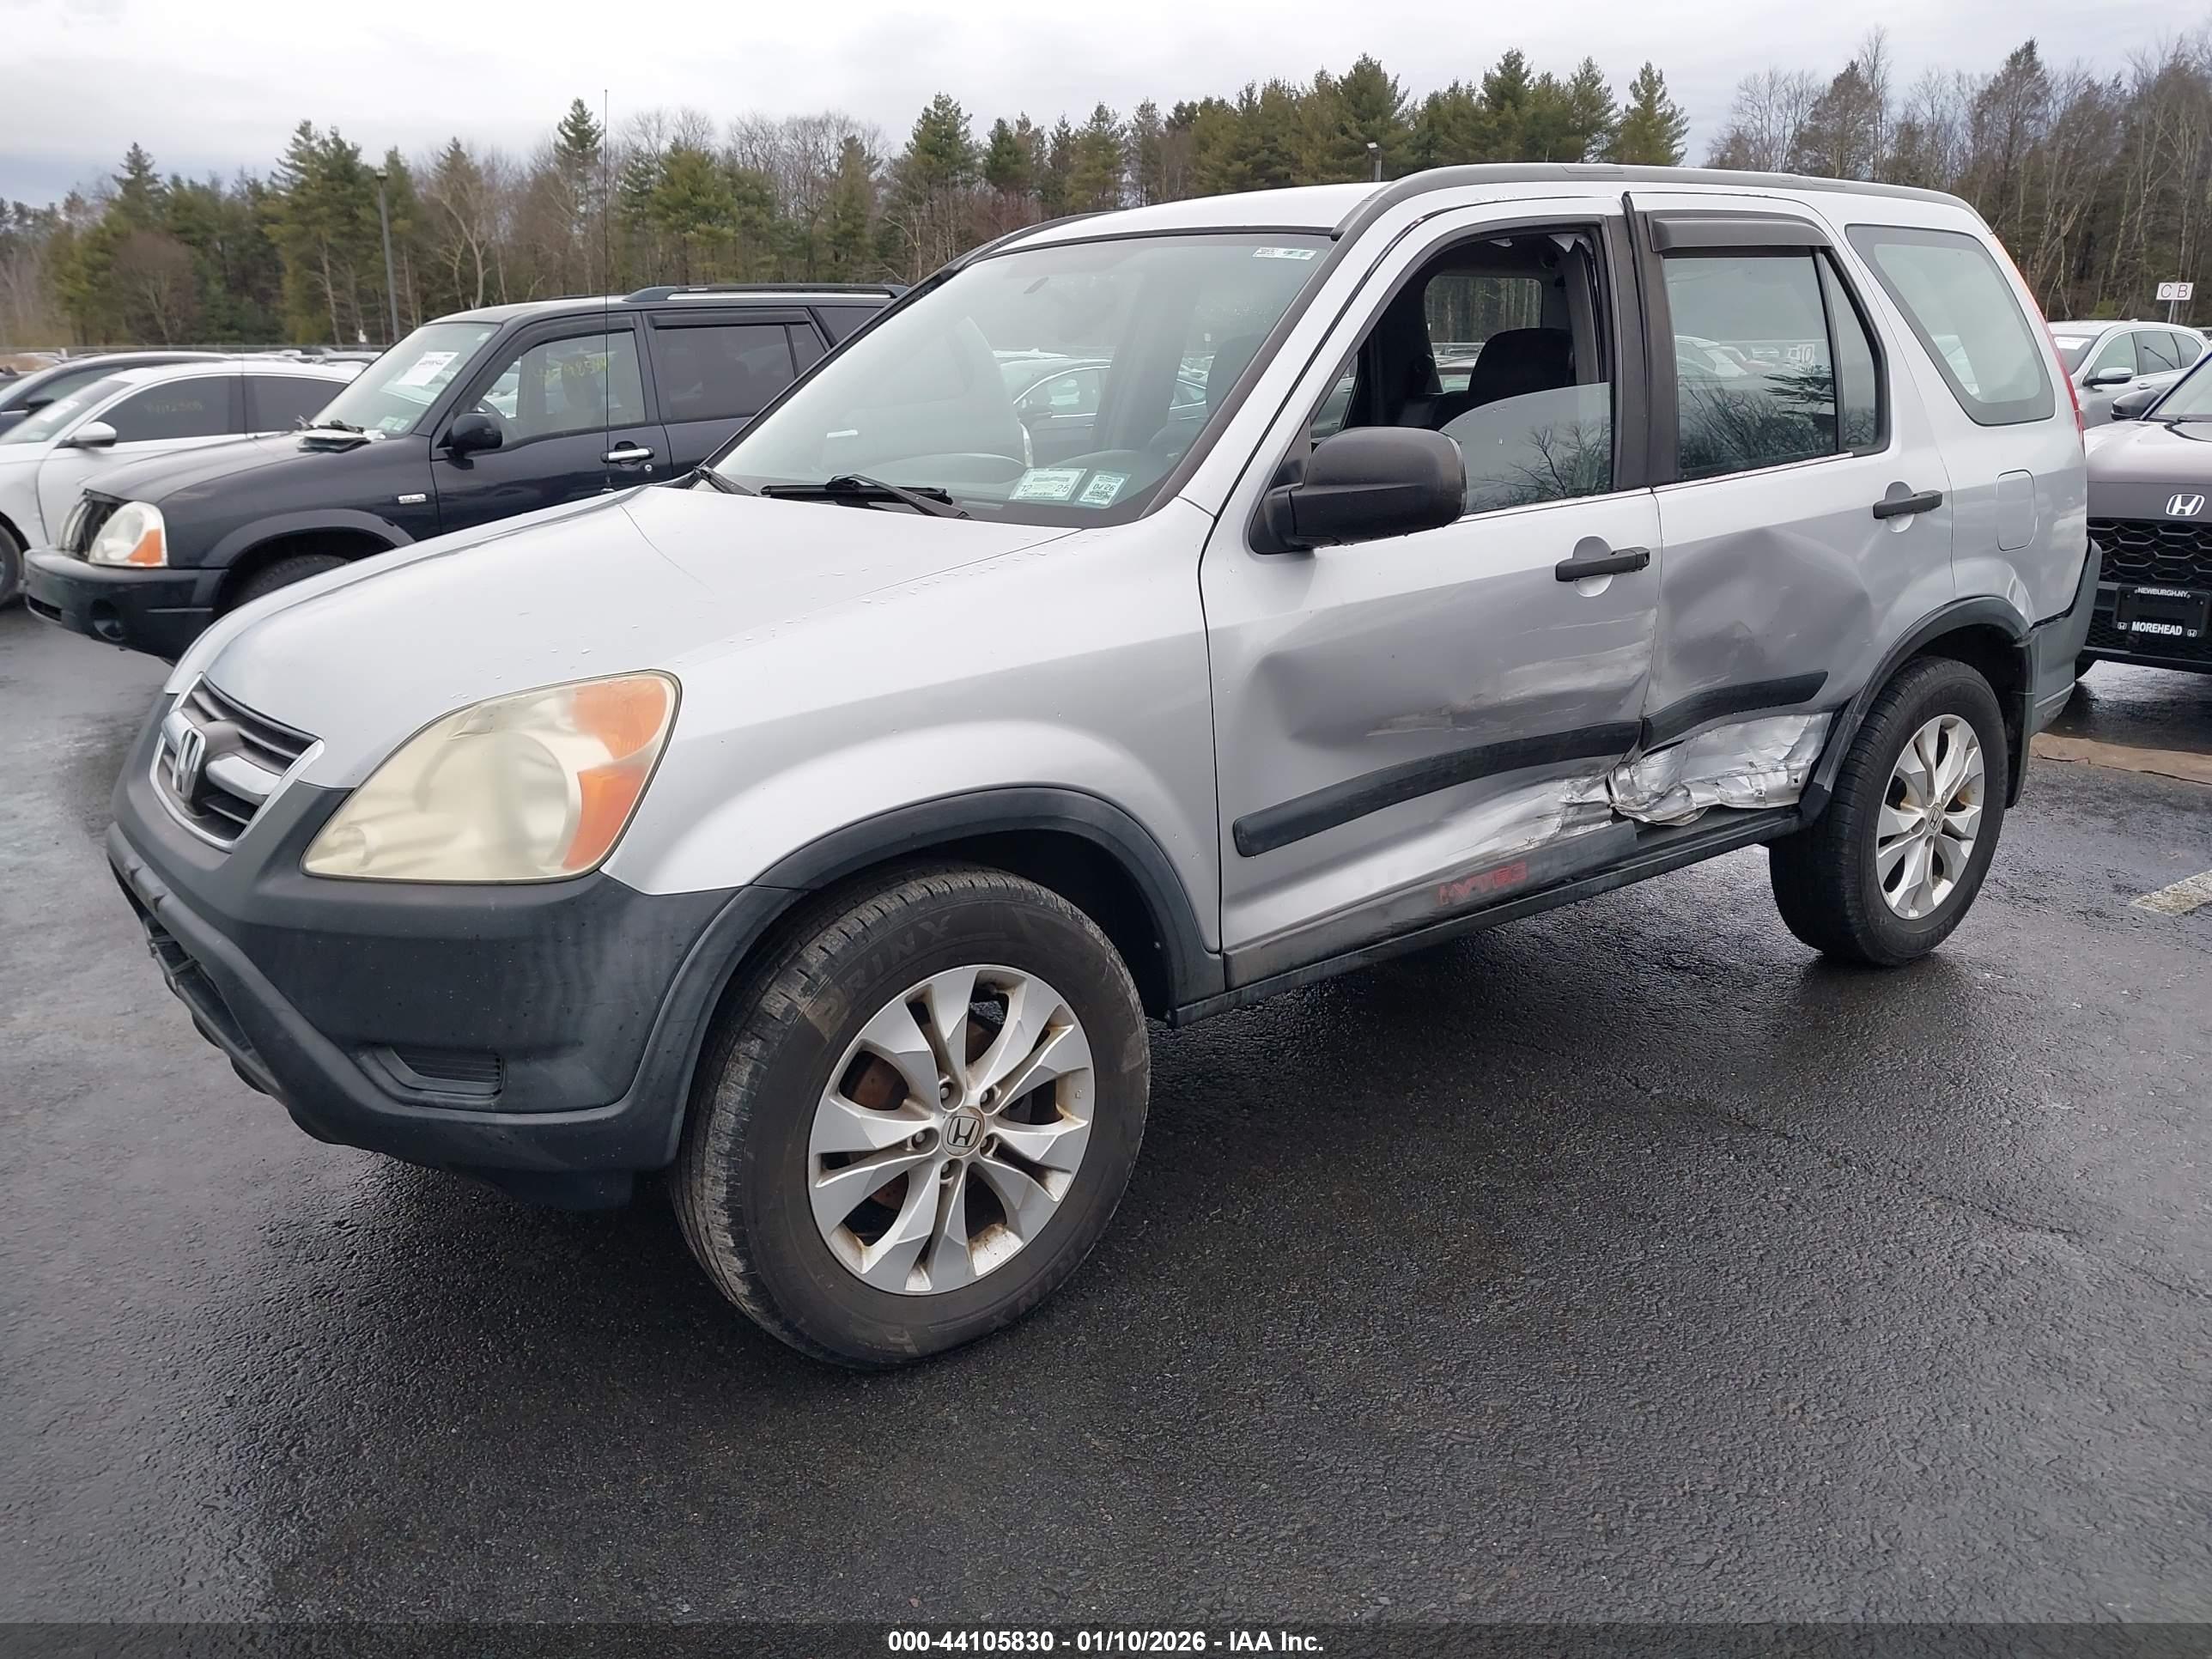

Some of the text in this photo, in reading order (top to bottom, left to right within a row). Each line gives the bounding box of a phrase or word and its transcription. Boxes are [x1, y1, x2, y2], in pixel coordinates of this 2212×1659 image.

[2160, 284, 2189, 298] C B
[2131, 621, 2183, 636] MOREHEAD
